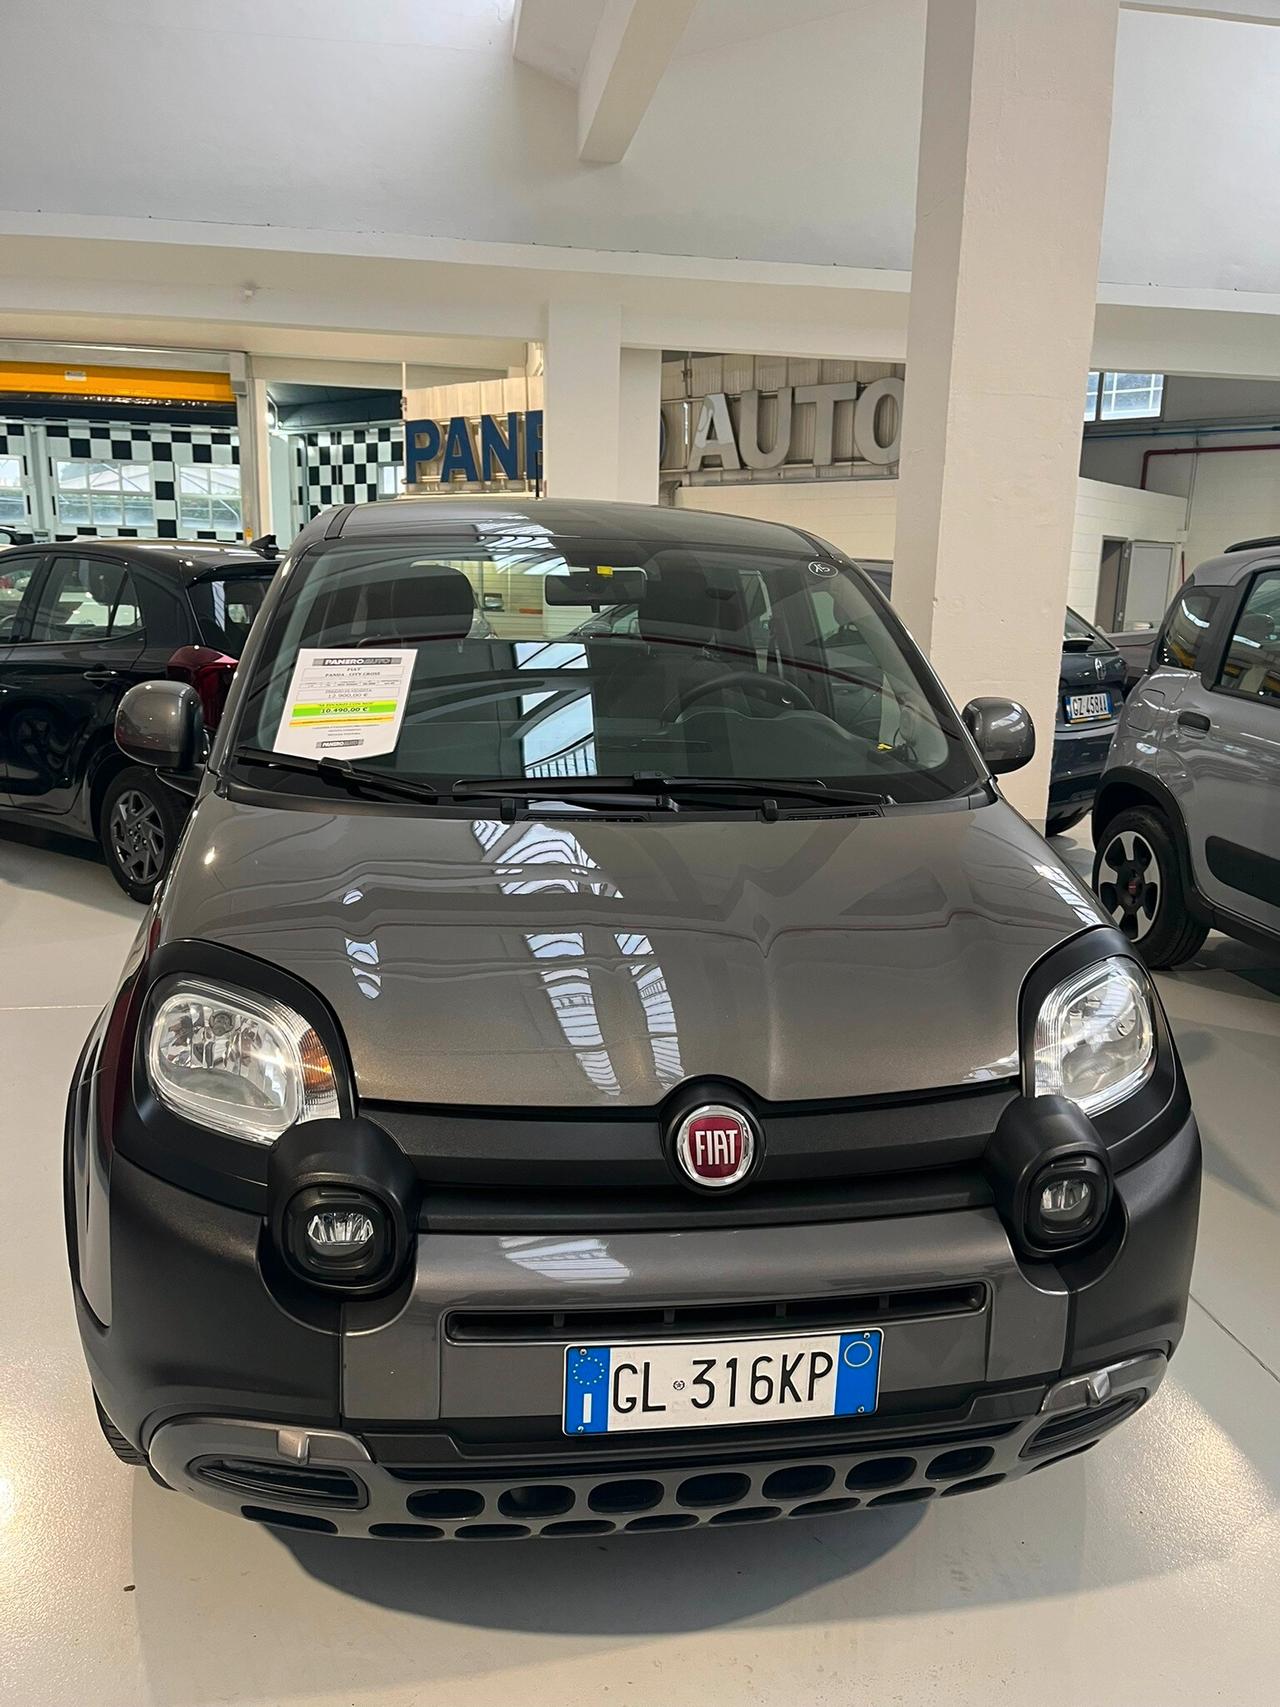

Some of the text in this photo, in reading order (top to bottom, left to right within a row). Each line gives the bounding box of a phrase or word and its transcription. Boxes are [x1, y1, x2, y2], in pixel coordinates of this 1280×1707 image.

[405, 376, 904, 484] PANE AUTO
[695, 1130, 738, 1166] FIAT
[612, 1361, 667, 1414] GL
[690, 1351, 833, 1409] 316KP
